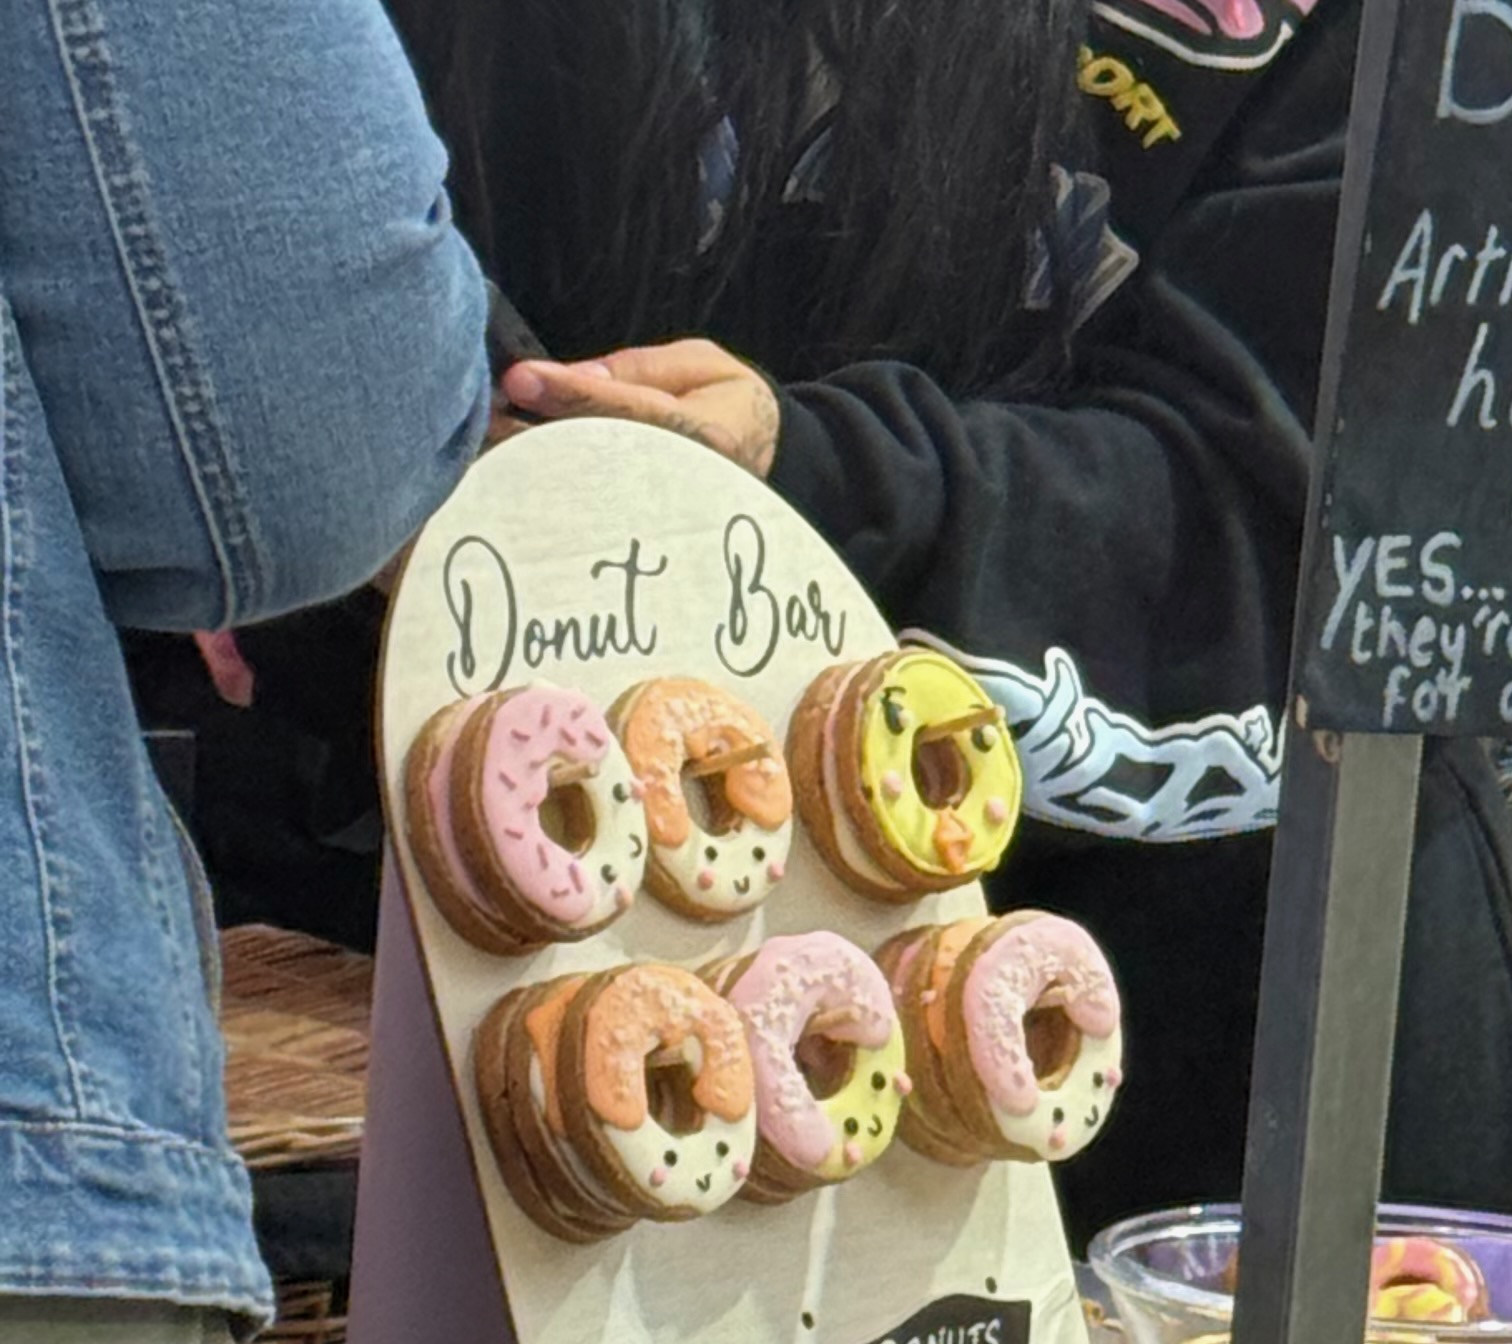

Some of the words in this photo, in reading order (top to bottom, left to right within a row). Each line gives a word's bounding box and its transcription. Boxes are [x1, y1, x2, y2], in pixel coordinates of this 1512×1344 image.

[442, 535, 668, 698] Donut
[715, 513, 846, 677] Bar
[1383, 666, 1472, 728] for
